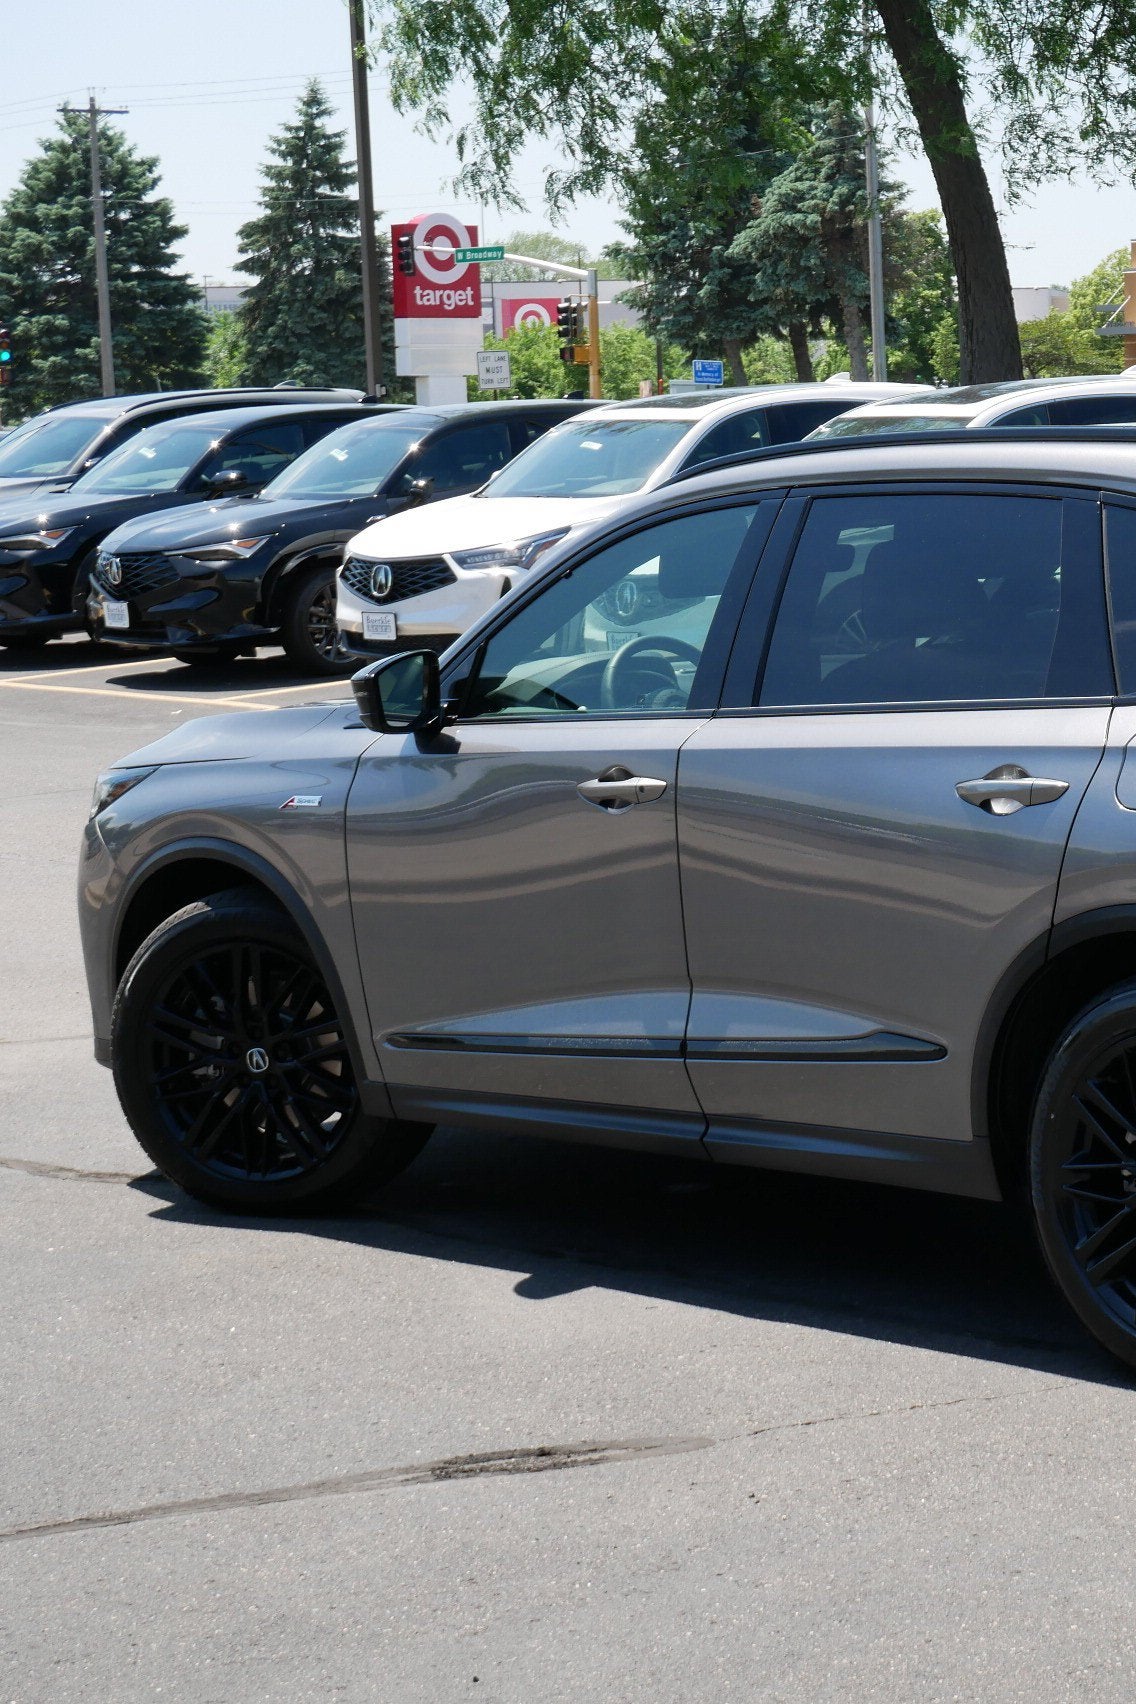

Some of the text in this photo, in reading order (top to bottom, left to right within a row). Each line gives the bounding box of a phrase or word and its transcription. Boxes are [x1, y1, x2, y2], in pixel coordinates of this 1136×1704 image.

[466, 250, 502, 260] Broadway
[414, 285, 475, 310] target
[486, 366, 503, 374] MUST
